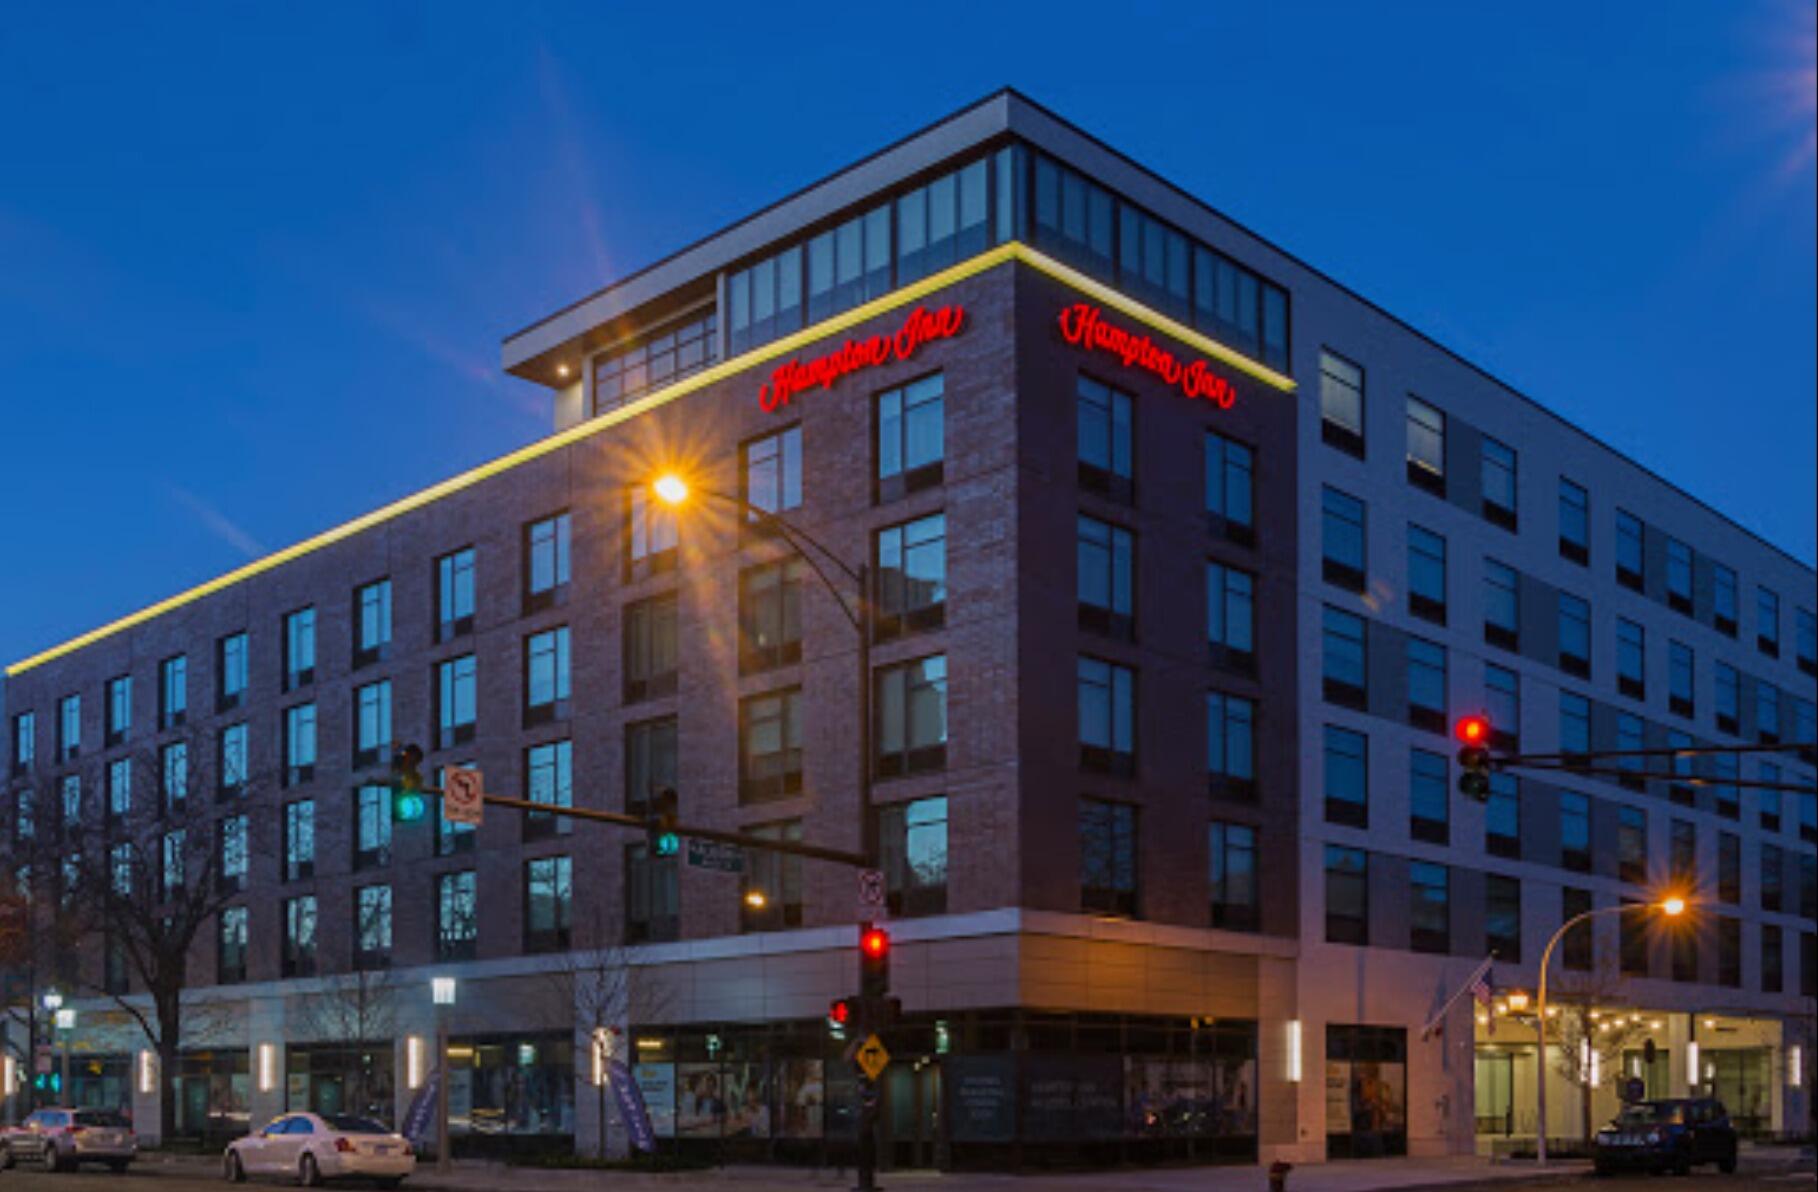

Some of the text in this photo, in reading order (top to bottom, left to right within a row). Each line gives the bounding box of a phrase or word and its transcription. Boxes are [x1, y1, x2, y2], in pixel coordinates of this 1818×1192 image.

[758, 305, 963, 413] Hampton Inn
[1060, 304, 1235, 409] Hampton Inn
